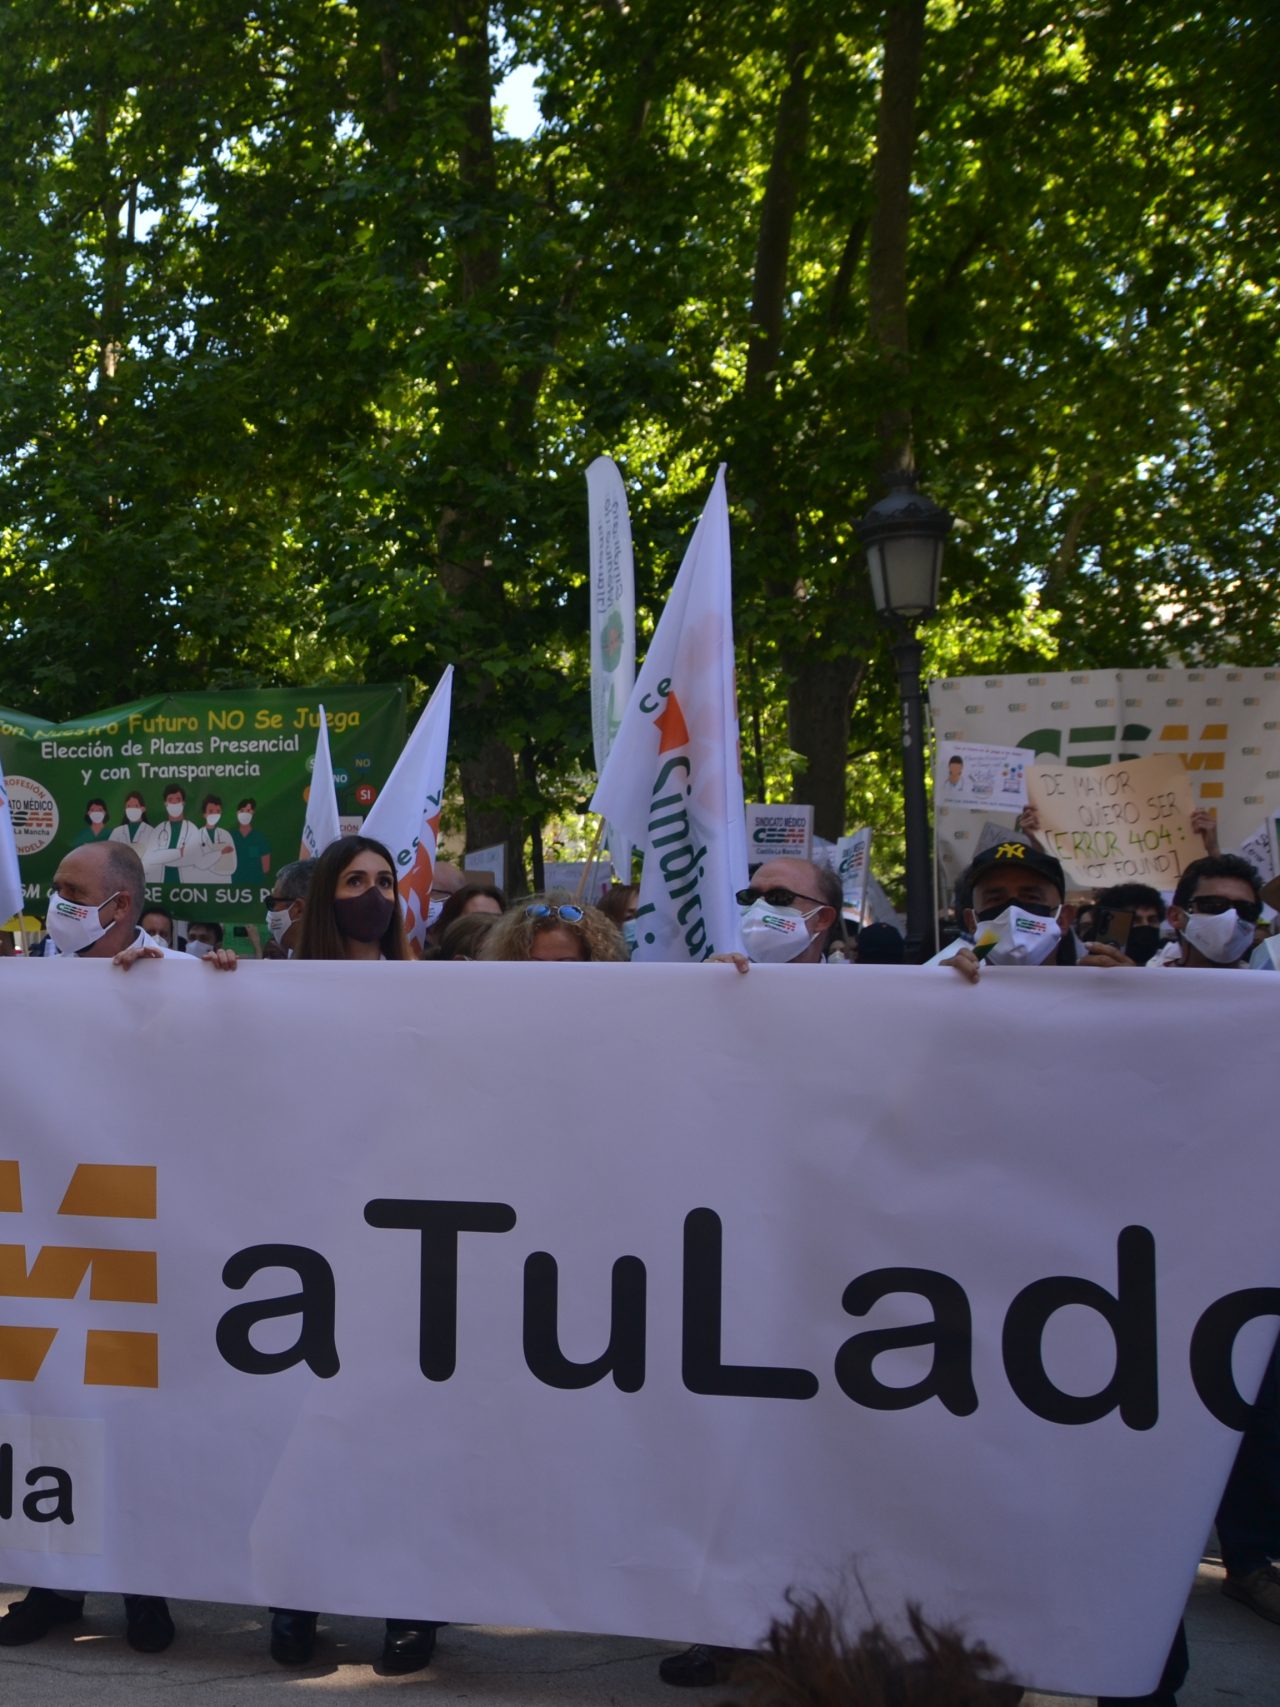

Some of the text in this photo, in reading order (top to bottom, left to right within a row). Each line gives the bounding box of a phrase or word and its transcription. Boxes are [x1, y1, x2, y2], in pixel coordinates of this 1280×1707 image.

[128, 713, 199, 735] Futuro
[208, 710, 244, 730] NO
[255, 709, 283, 729] Se
[294, 707, 360, 732] Juega
[41, 734, 300, 759] Elección de Plazas Presencial
[81, 760, 261, 785] y con Transparencia
[354, 758, 371, 768] NO
[1040, 771, 1136, 798] DE MAYOR
[23, 797, 54, 811] MÉDICO
[1147, 792, 1182, 821] SER
[24, 828, 51, 836] Mancha
[170, 888, 208, 903] CON
[216, 888, 253, 903] SUS
